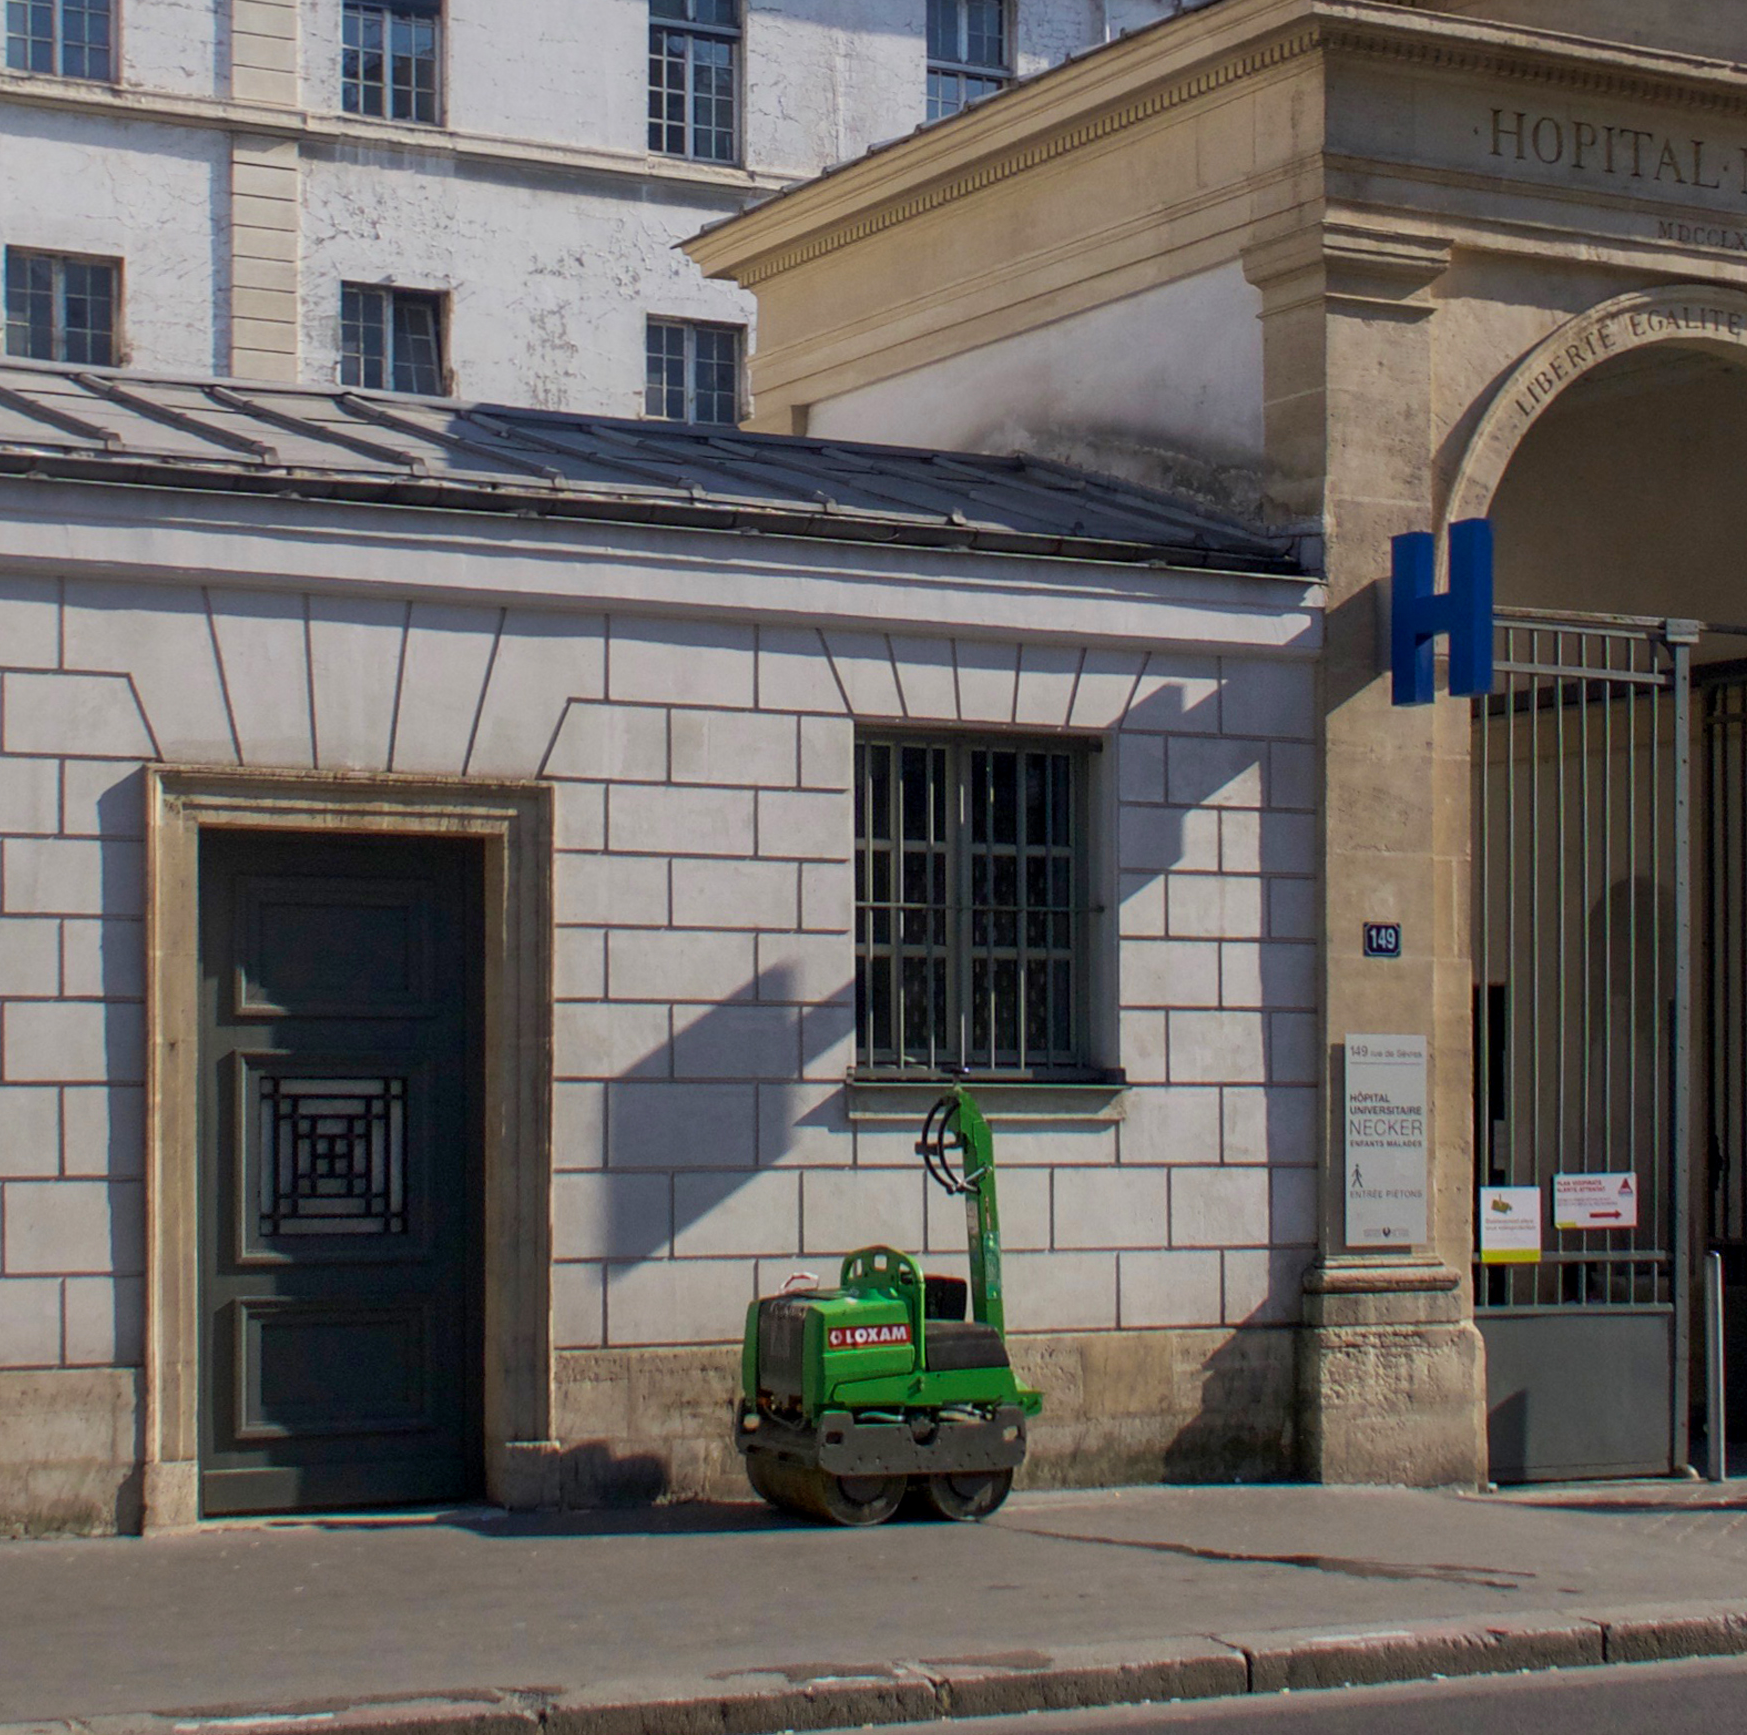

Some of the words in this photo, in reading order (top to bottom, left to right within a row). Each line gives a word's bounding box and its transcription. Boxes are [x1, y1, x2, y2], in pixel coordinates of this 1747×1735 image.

[1489, 107, 1721, 188] HOPITAL
[1391, 518, 1494, 706] H
[1369, 928, 1396, 949] 149
[1350, 1045, 1369, 1058] 149
[1349, 1091, 1391, 1103] HÔPITAL
[1349, 1105, 1423, 1116] UNIVERSITAIRE
[1349, 1118, 1423, 1136] NECKER
[1349, 1139, 1384, 1148] ENFANTS
[1386, 1139, 1423, 1148] MALADES
[1349, 1189, 1383, 1199] ENTRÉE
[845, 1326, 907, 1344] LOXAM
